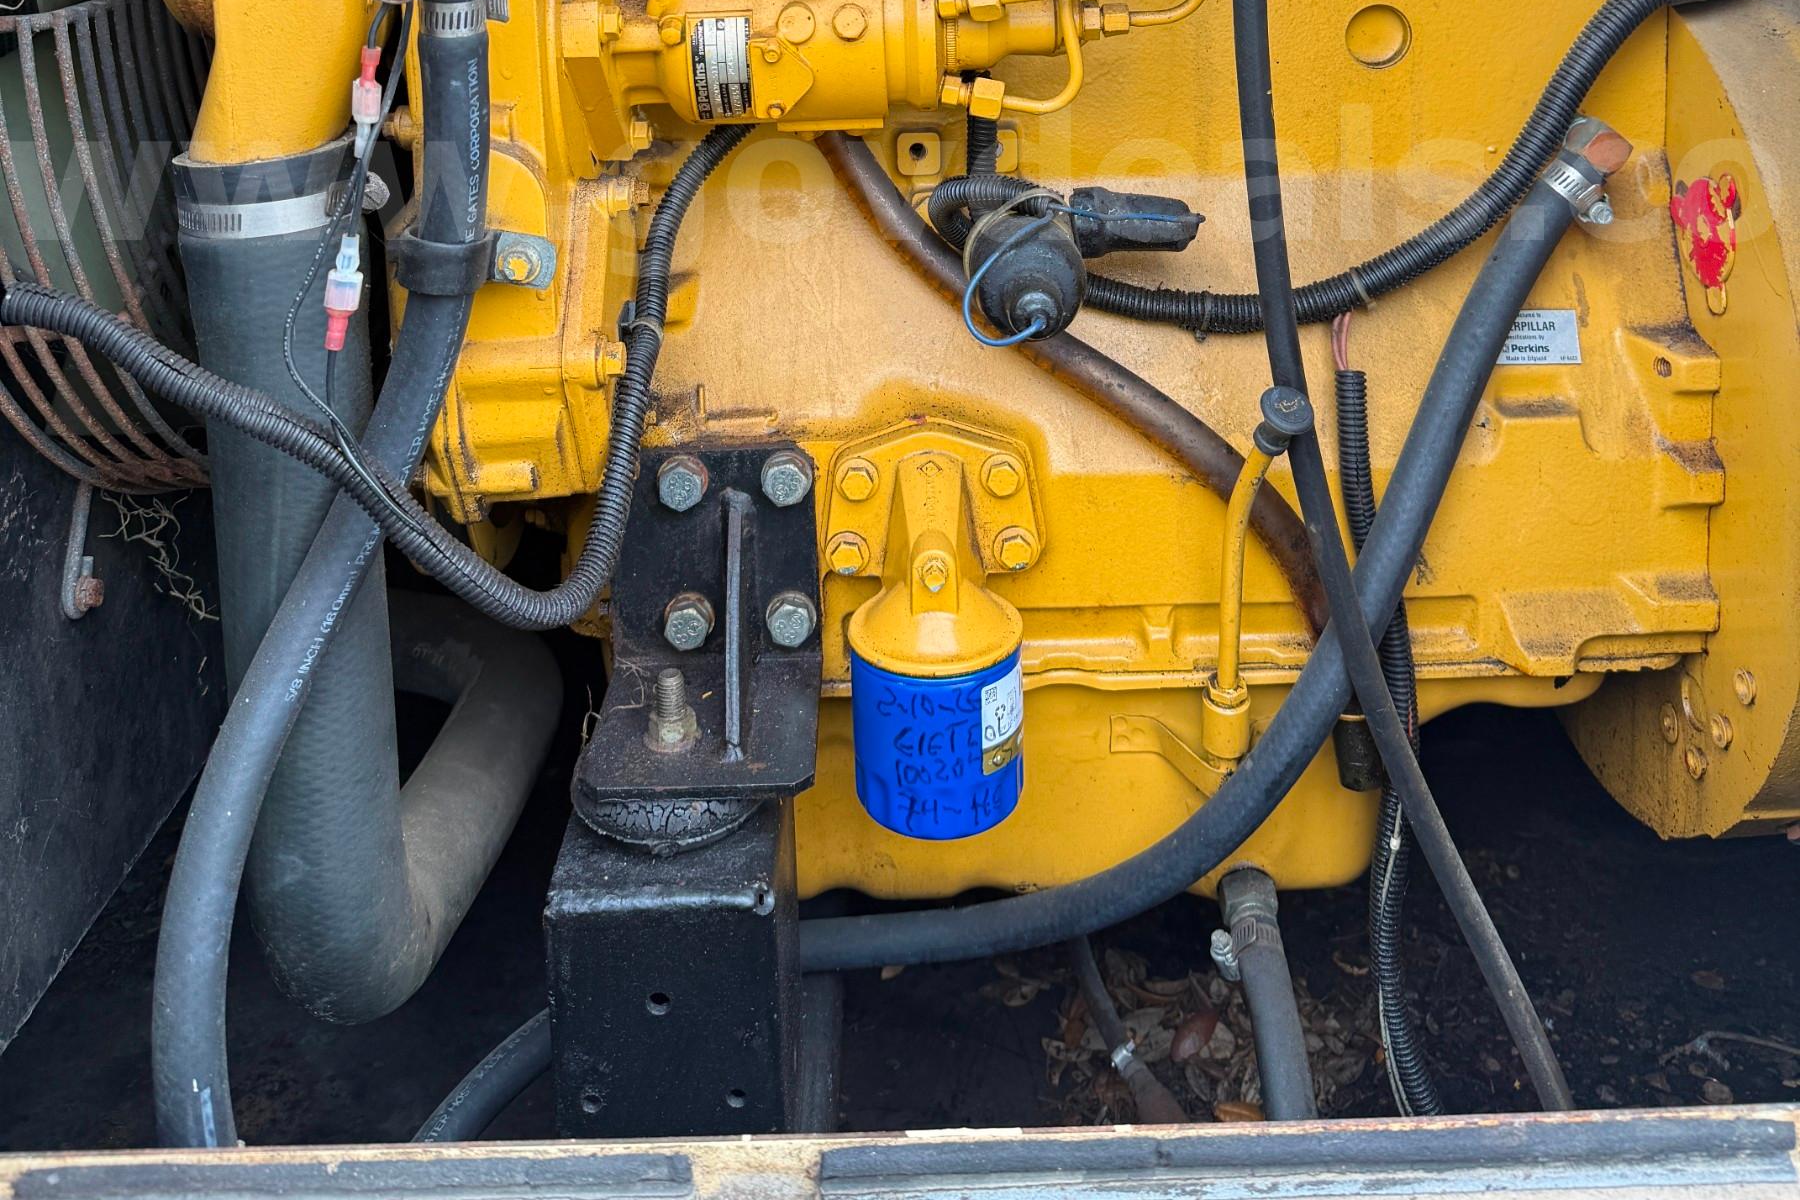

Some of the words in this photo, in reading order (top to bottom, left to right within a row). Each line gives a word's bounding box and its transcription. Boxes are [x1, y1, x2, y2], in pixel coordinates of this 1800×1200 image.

[467, 56, 481, 171] CORPORATION
[466, 173, 480, 223] GATES
[1511, 343, 1550, 353] Perkins
[297, 637, 325, 675] INCH
